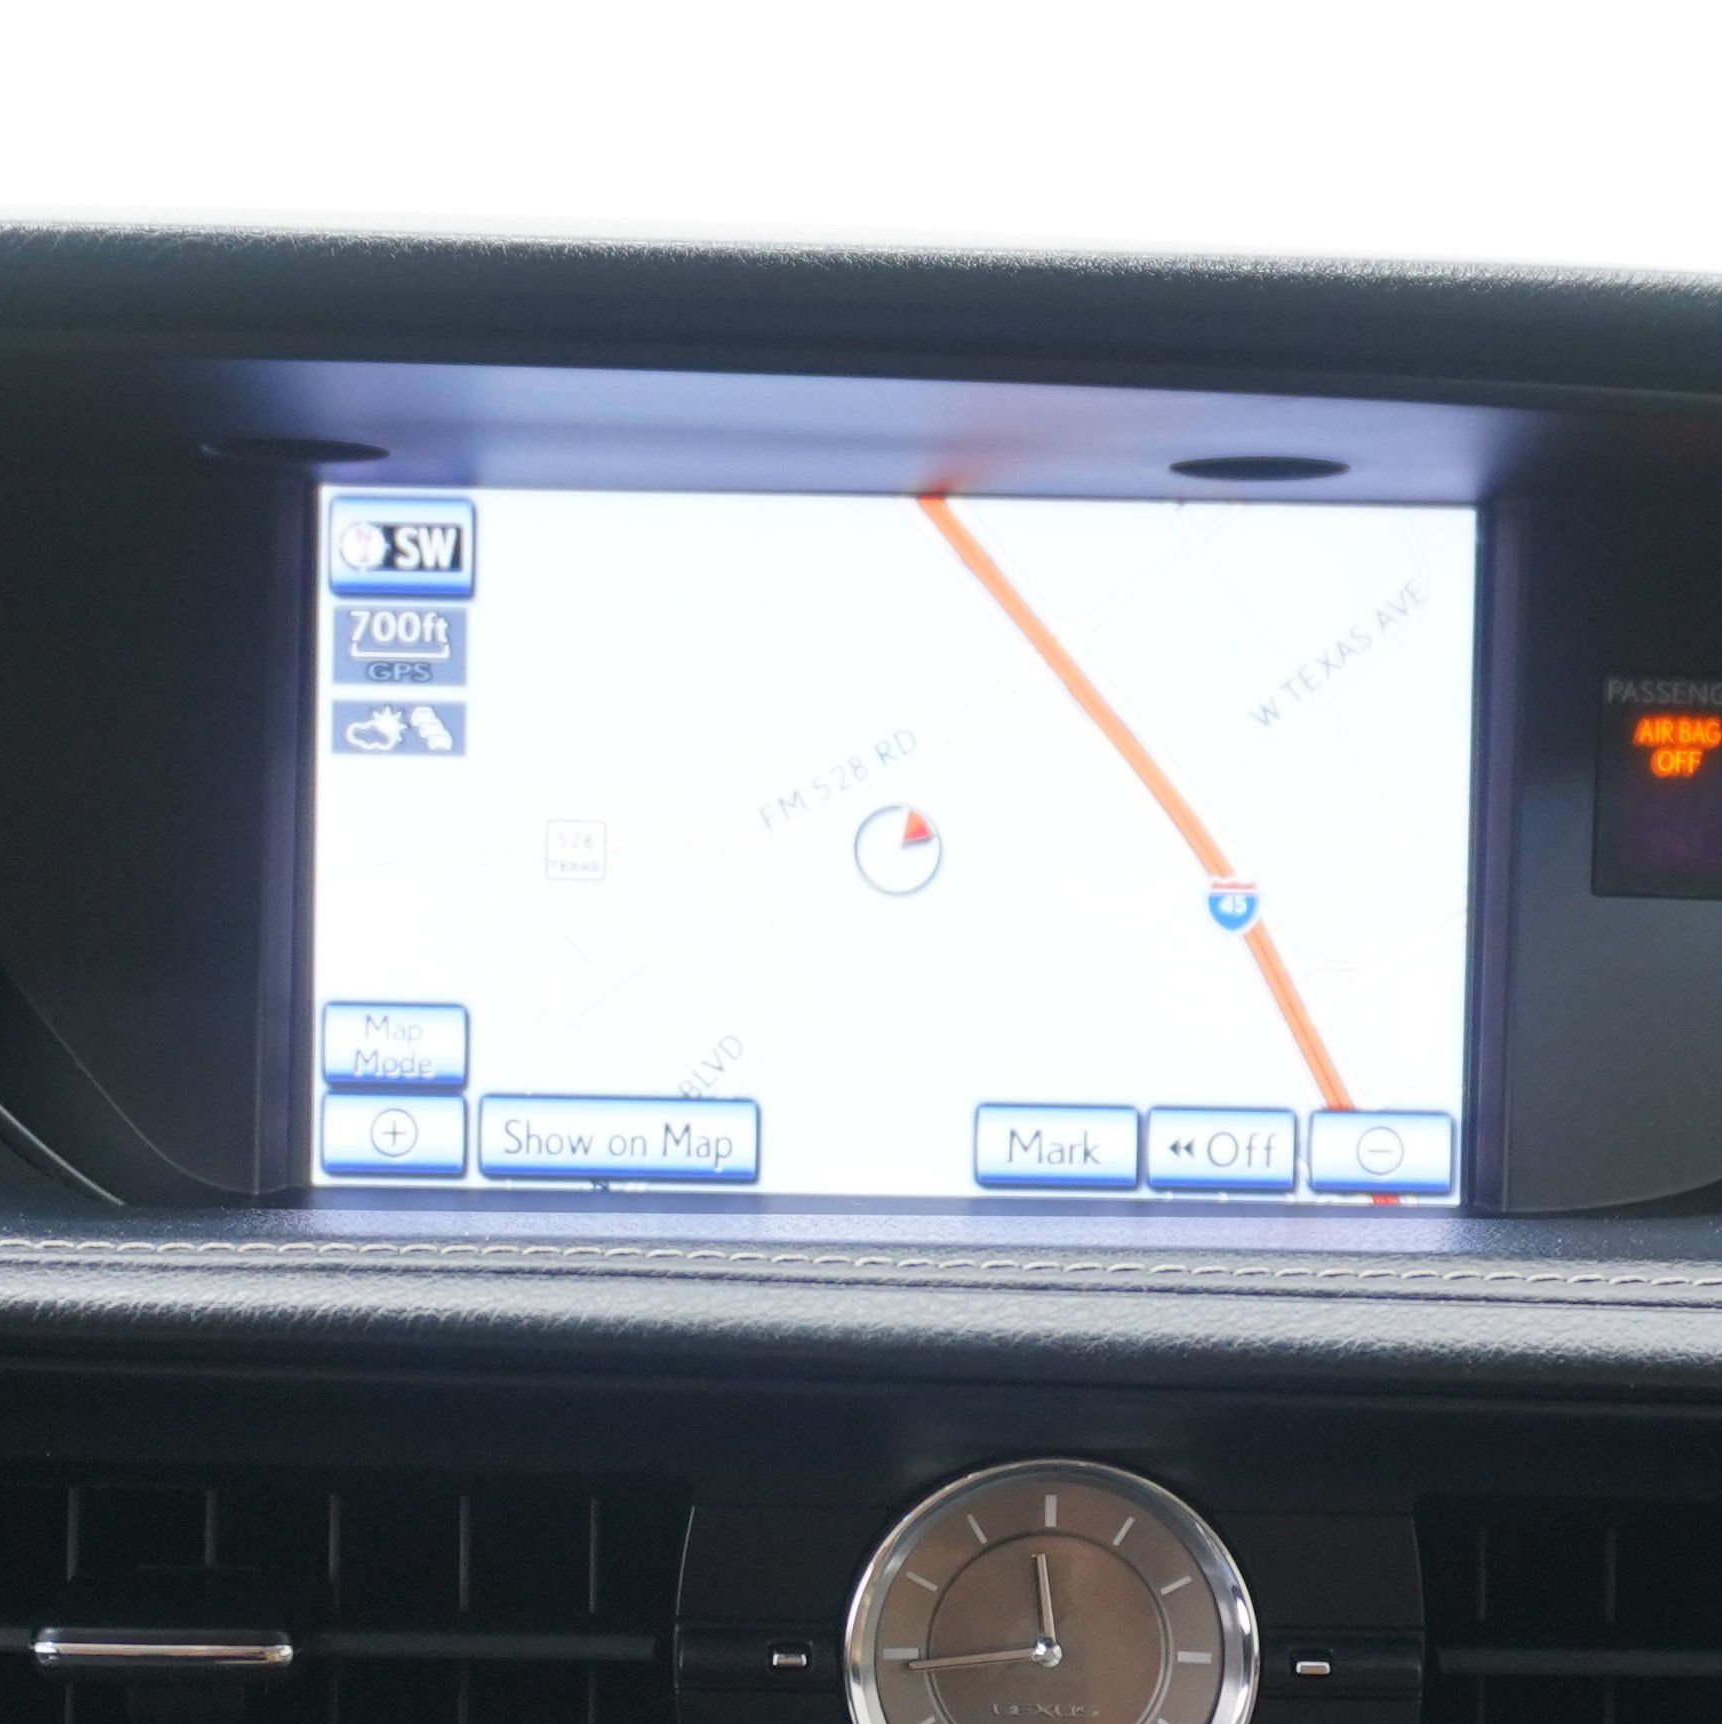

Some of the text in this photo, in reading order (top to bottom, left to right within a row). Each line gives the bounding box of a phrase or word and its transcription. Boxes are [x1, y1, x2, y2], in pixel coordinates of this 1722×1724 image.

[394, 527, 457, 570] SW
[349, 610, 448, 642] 700ft
[1249, 578, 1423, 730] W TEXAS AVE
[367, 661, 432, 682] GPS
[1635, 718, 1676, 745] AIR
[1652, 748, 1703, 776] OFF
[759, 729, 917, 831] FM 528 RD
[557, 832, 594, 849] 528
[550, 860, 602, 873] TEXAS
[1218, 894, 1248, 917] 45
[364, 1014, 423, 1046] Map
[353, 1049, 433, 1077] Mode
[677, 1034, 745, 1099] BLVD
[503, 1119, 734, 1169] Show on Map
[1008, 1127, 1101, 1166] Mark
[1207, 1131, 1277, 1169] Off
